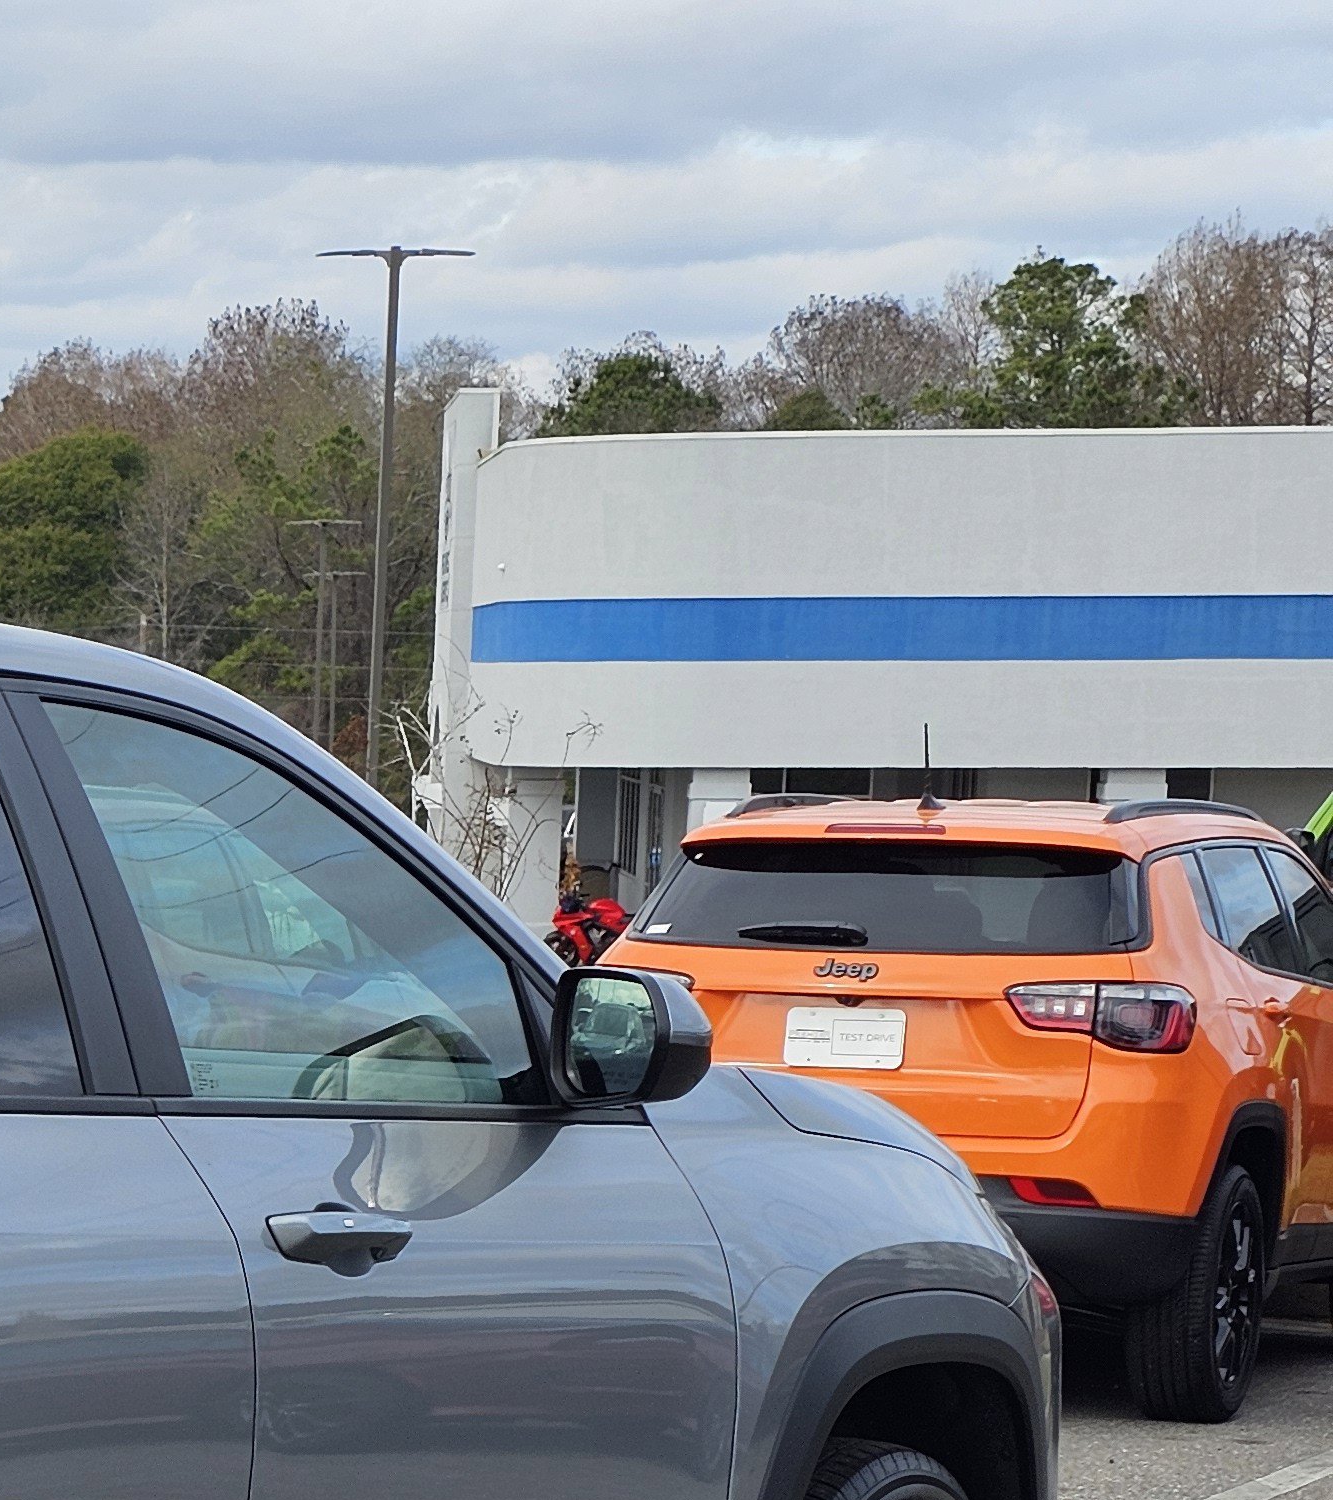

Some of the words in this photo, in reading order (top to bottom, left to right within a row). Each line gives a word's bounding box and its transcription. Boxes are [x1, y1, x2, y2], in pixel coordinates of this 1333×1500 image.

[814, 958, 879, 981] Jeep
[840, 1033, 864, 1042] TEST
[867, 1033, 896, 1043] DRIVE
